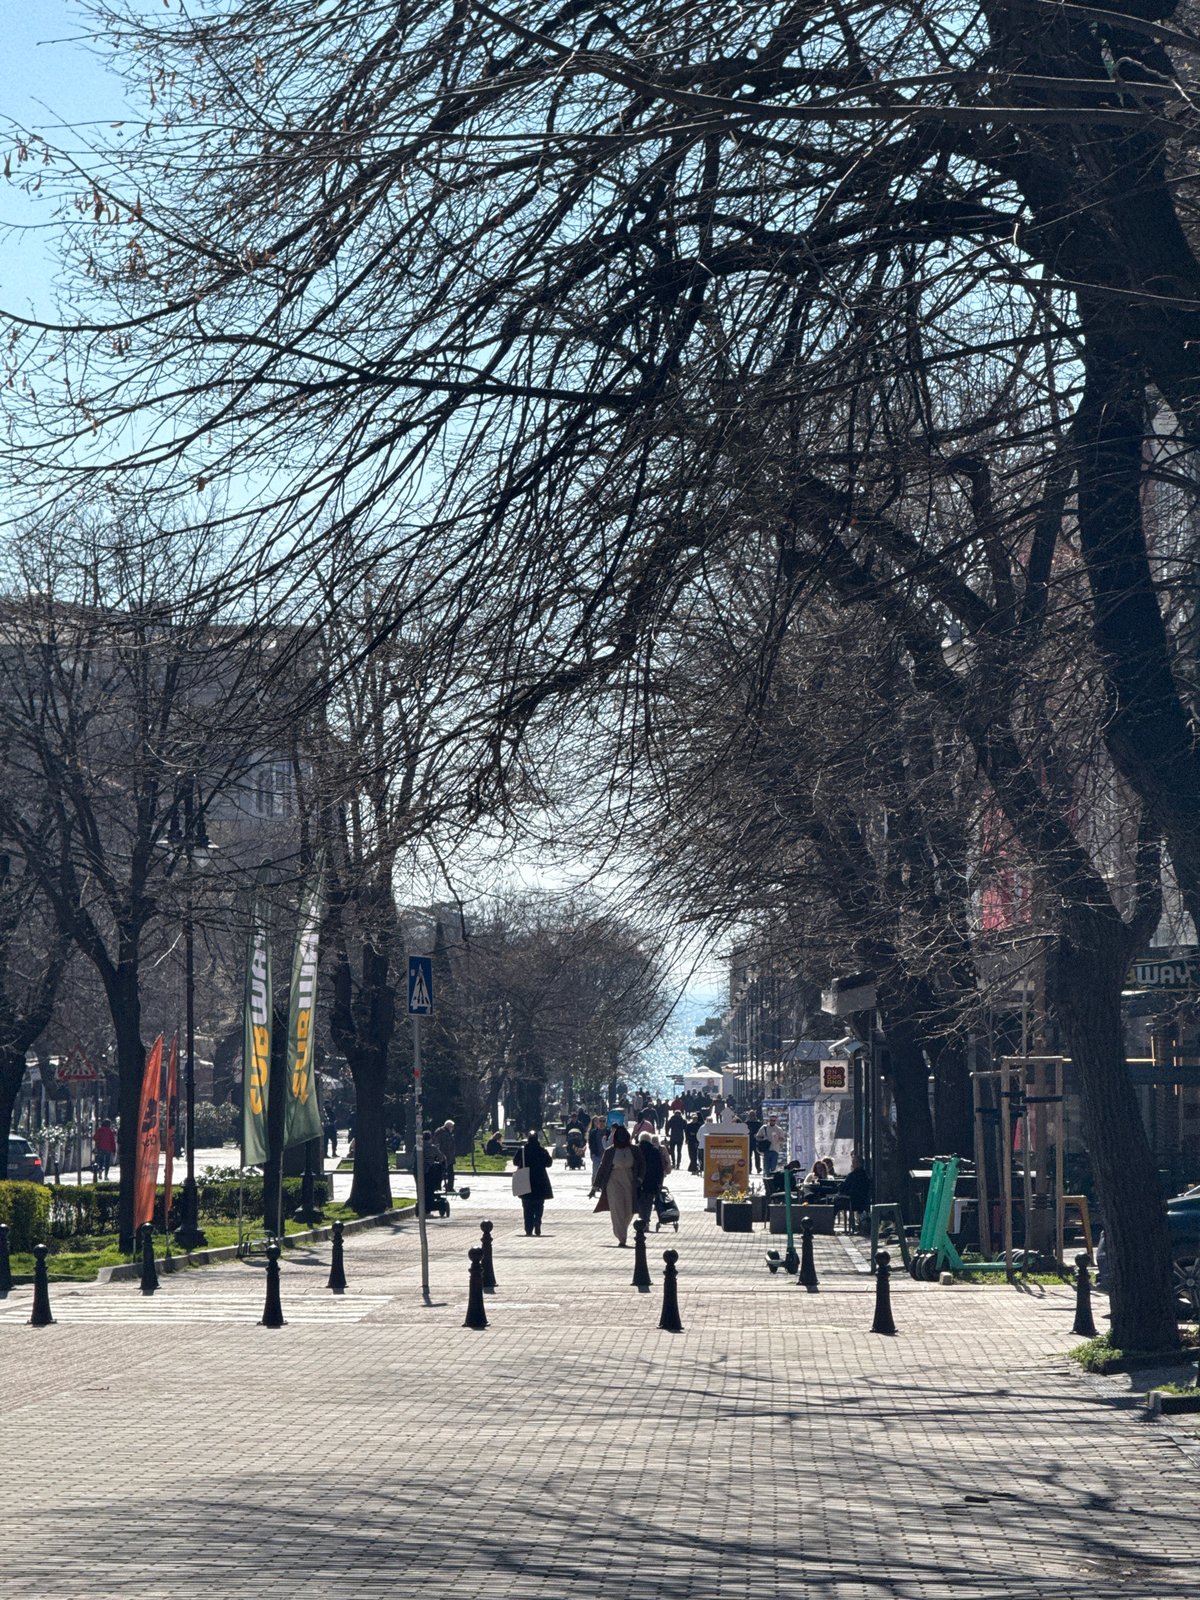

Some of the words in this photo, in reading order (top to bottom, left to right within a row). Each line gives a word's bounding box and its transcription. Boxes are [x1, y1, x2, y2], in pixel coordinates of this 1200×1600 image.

[250, 901, 268, 1114] SUBWAY
[292, 892, 319, 1104] SUBWAY
[1125, 963, 1196, 984] BWAY
